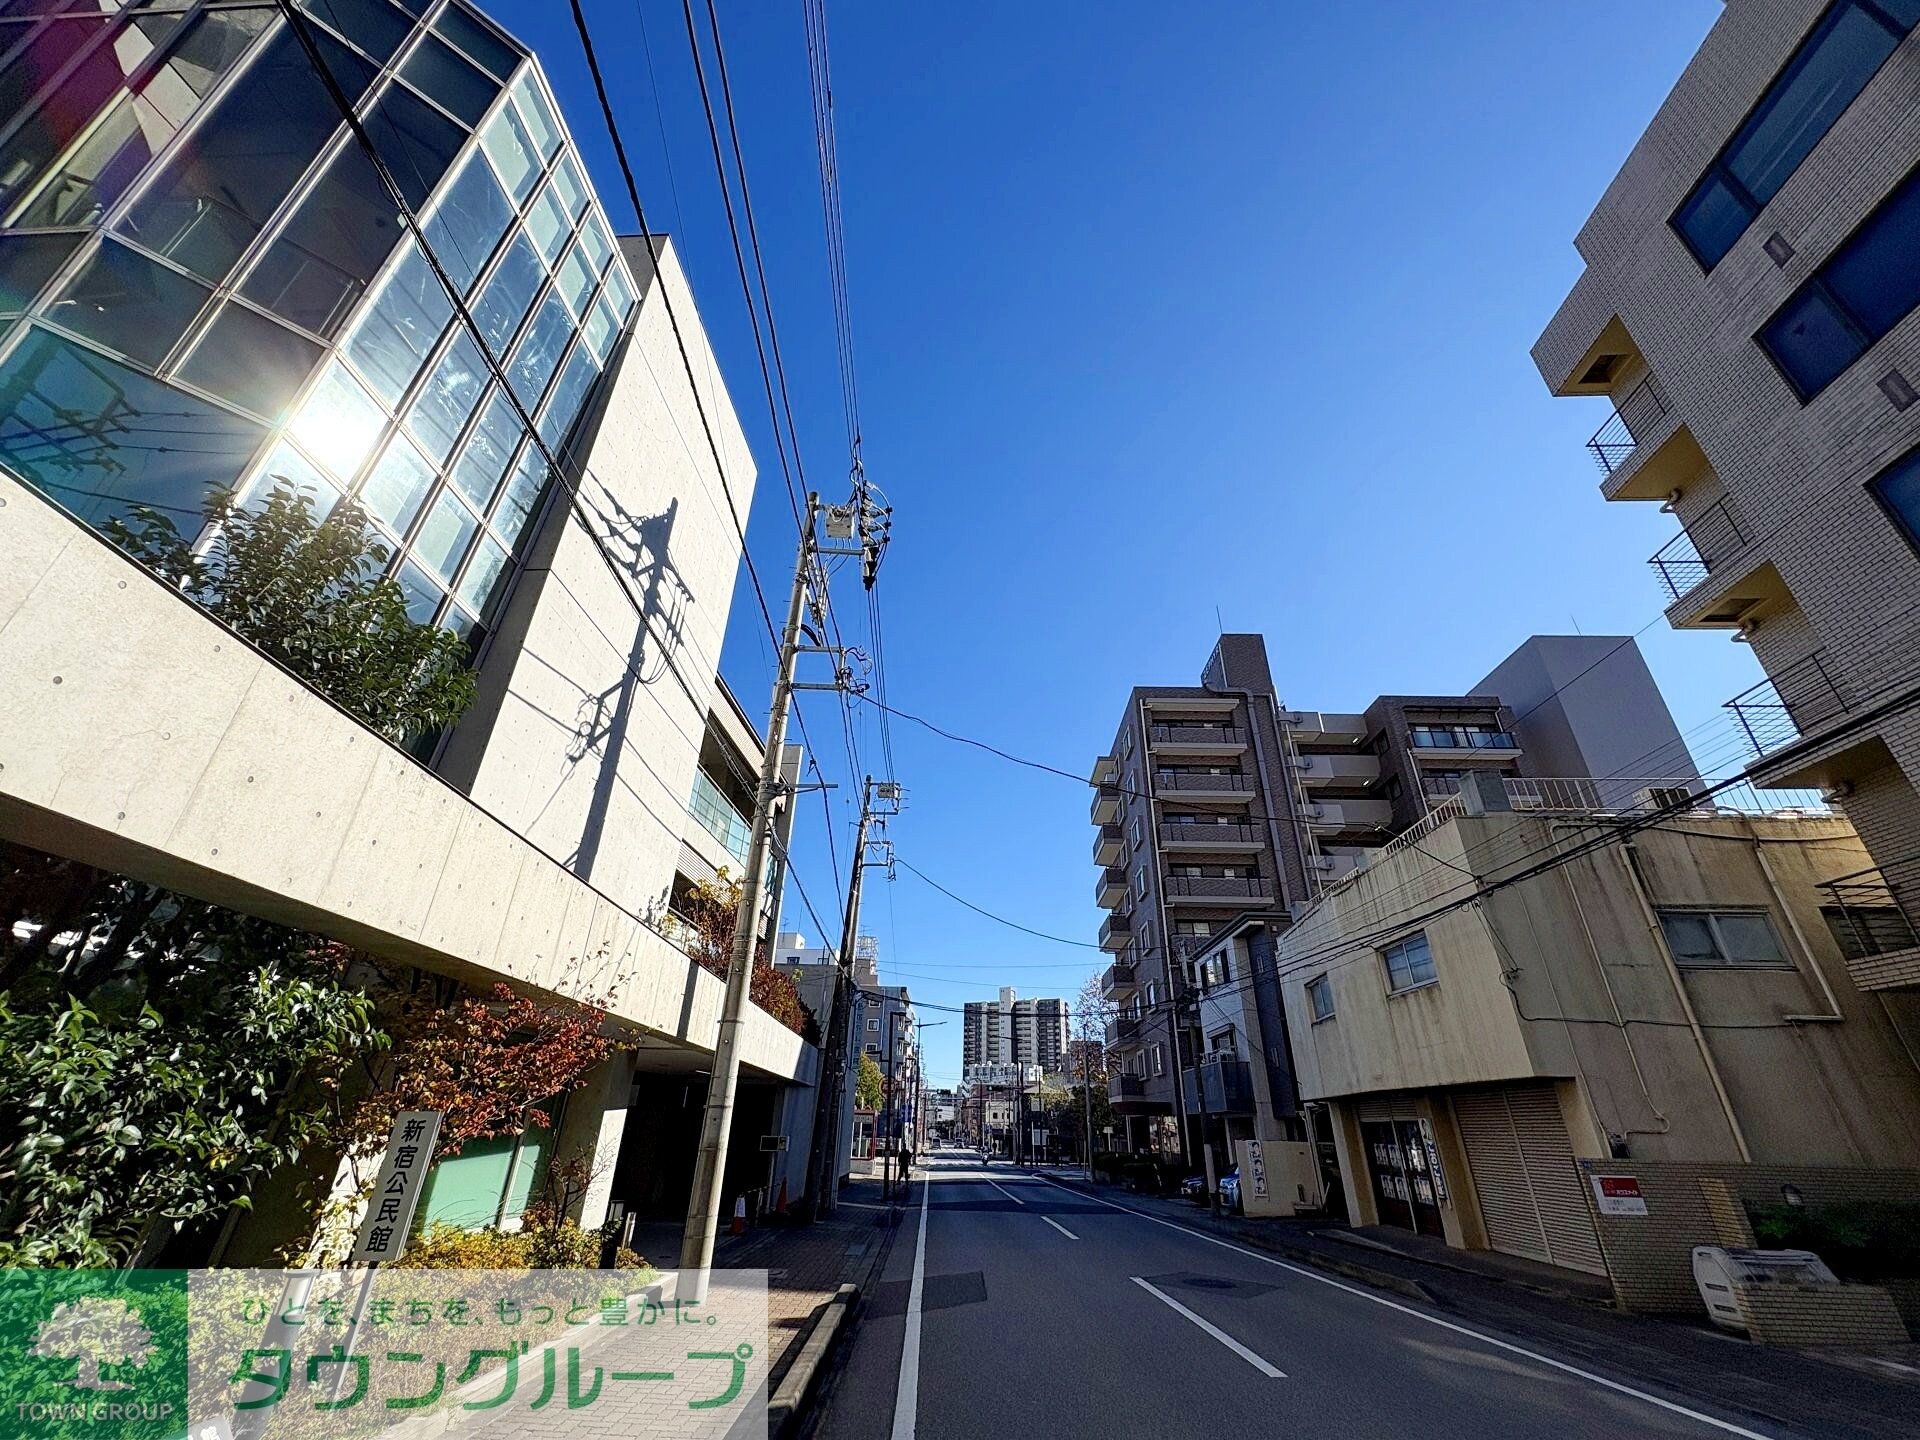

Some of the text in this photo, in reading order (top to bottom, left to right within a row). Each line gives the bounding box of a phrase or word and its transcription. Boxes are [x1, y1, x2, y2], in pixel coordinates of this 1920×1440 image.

[365, 1119, 426, 1252] 新宿公民館
